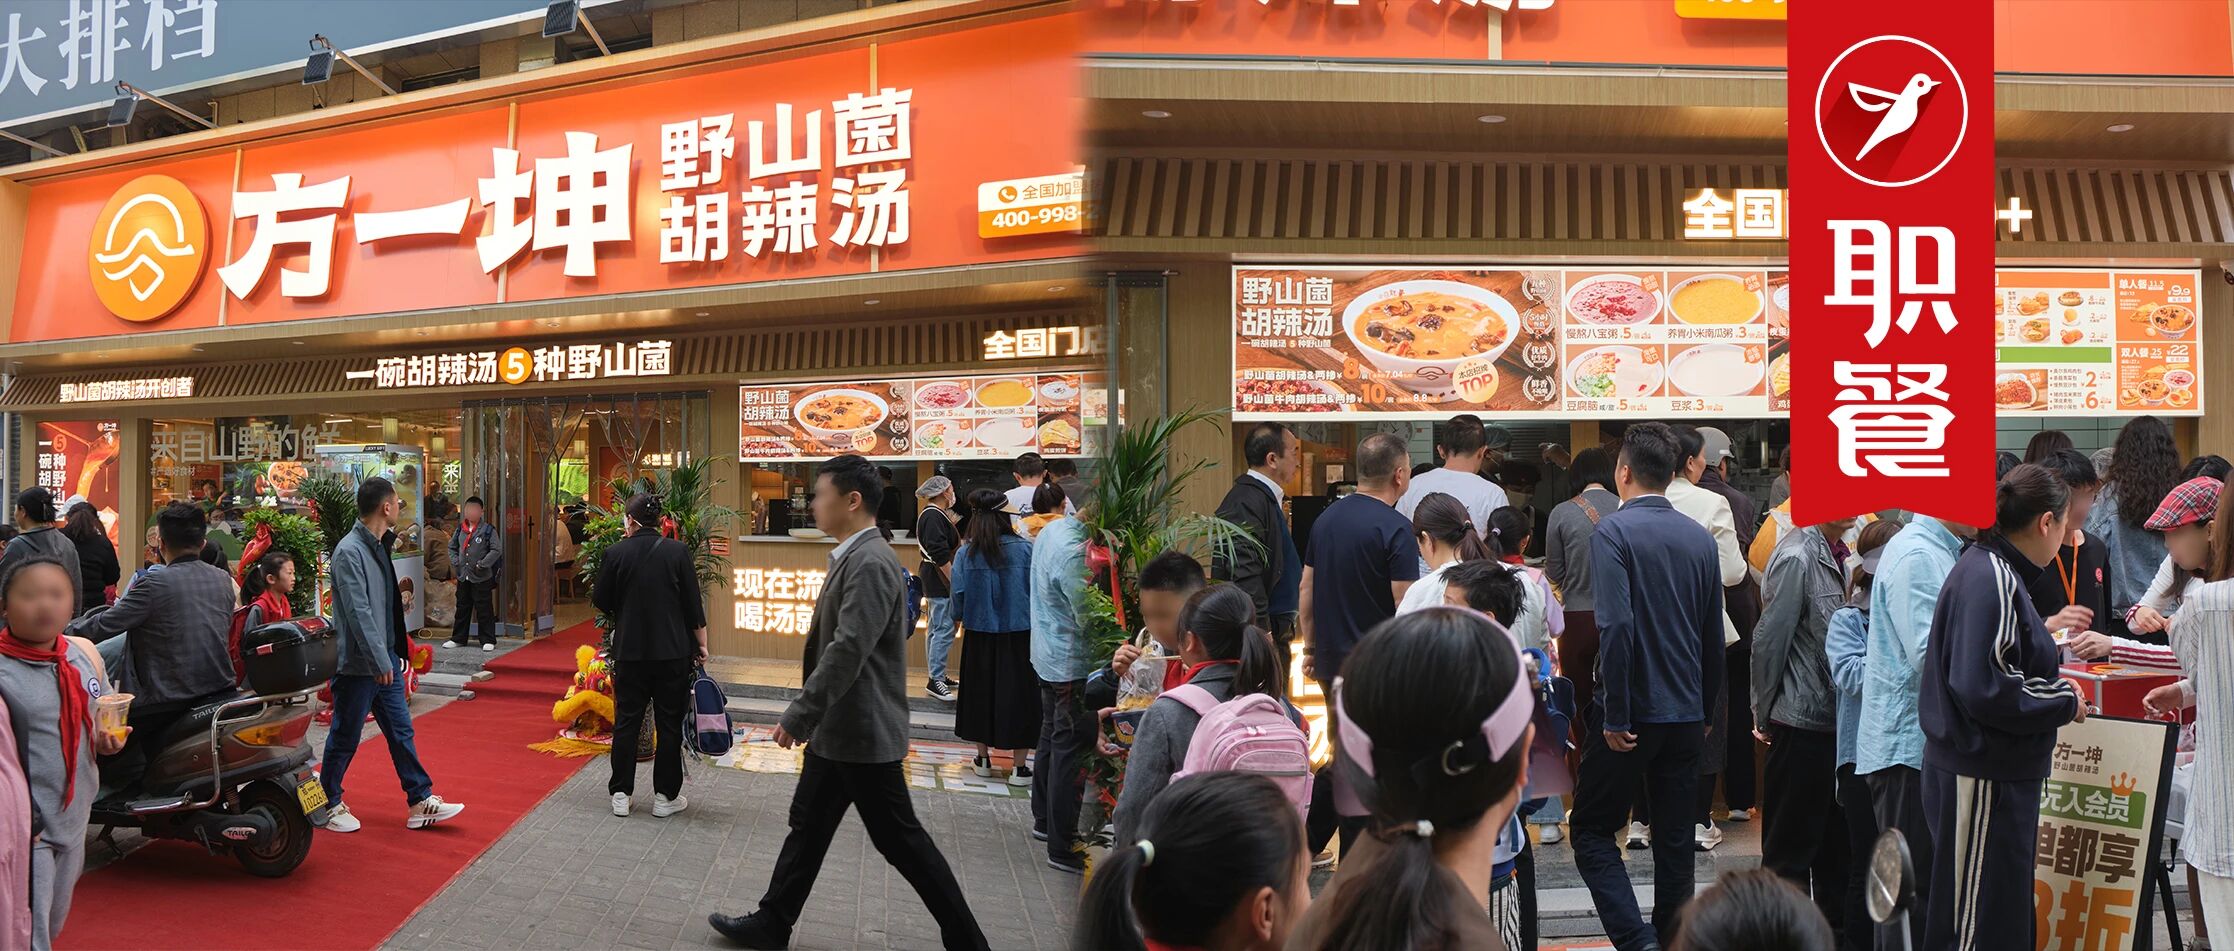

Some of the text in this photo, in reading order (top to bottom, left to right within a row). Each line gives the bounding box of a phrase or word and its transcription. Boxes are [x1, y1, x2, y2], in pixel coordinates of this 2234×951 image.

[0, 0, 216, 95] 大排档
[660, 88, 913, 192] 野山菌
[217, 131, 634, 300] 方一坤
[660, 169, 910, 264] 胡辣汤
[1684, 188, 1789, 239] 全国
[1242, 277, 1334, 305] 野山菌
[1241, 307, 1334, 337] 胡辣汤
[1566, 328, 1618, 340] 慢熬八宝粥
[1668, 328, 1733, 339] 养胃小米南瓜粥
[60, 377, 194, 403] 野山菌胡辣汤开创者
[1460, 374, 1493, 394] TOP
[744, 390, 790, 405] 野山菌
[1567, 400, 1598, 411] 豆腐脑
[1671, 401, 1692, 411] 豆浆
[744, 405, 790, 421] 胡辣汤
[2054, 742, 2103, 765] 方一坤
